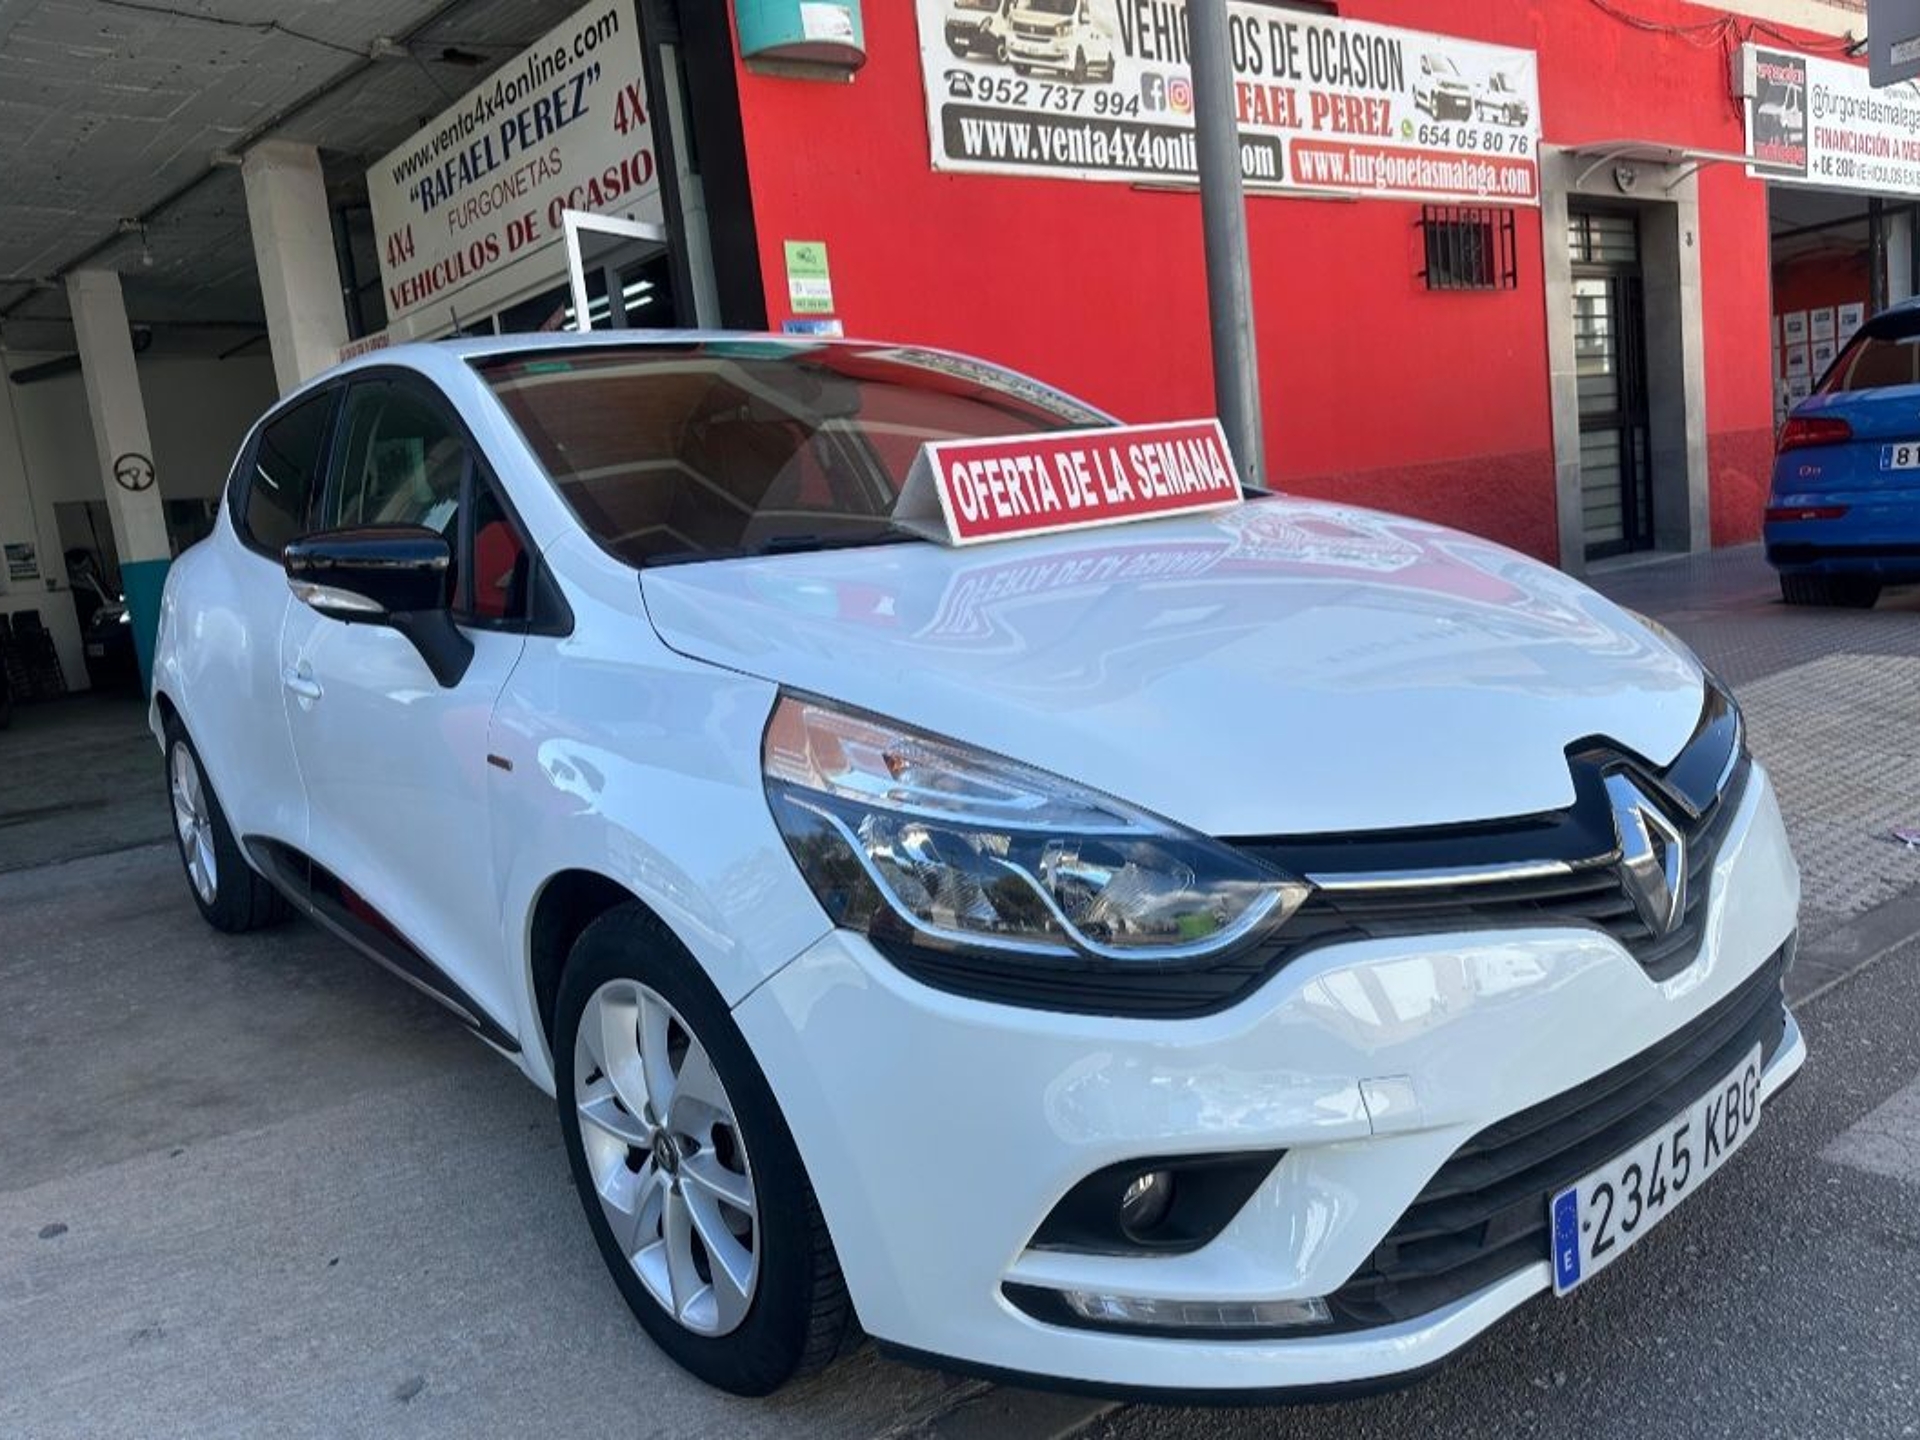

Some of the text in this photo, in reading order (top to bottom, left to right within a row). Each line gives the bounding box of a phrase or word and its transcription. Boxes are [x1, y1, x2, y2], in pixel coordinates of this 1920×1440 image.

[1269, 20, 1301, 80] DE
[1307, 26, 1405, 94] OCASION
[391, 9, 619, 186] www.venta4x4online.com
[977, 76, 1140, 117] 952 737 994
[1236, 81, 1394, 138] FAEL PEREZ
[1418, 124, 1529, 154] 654 05 80 76
[1821, 155, 1834, 175] DE
[448, 147, 563, 235] FURGONETAS
[1297, 149, 1531, 195] www.furgonetasmalaga.com
[386, 224, 415, 270] 4X4
[389, 233, 499, 311] VEHICULOS
[506, 211, 541, 252] DE
[952, 437, 1232, 523] OFERTA DE LA SEMANA
[1564, 1064, 1757, 1272] E 2345 KBG
